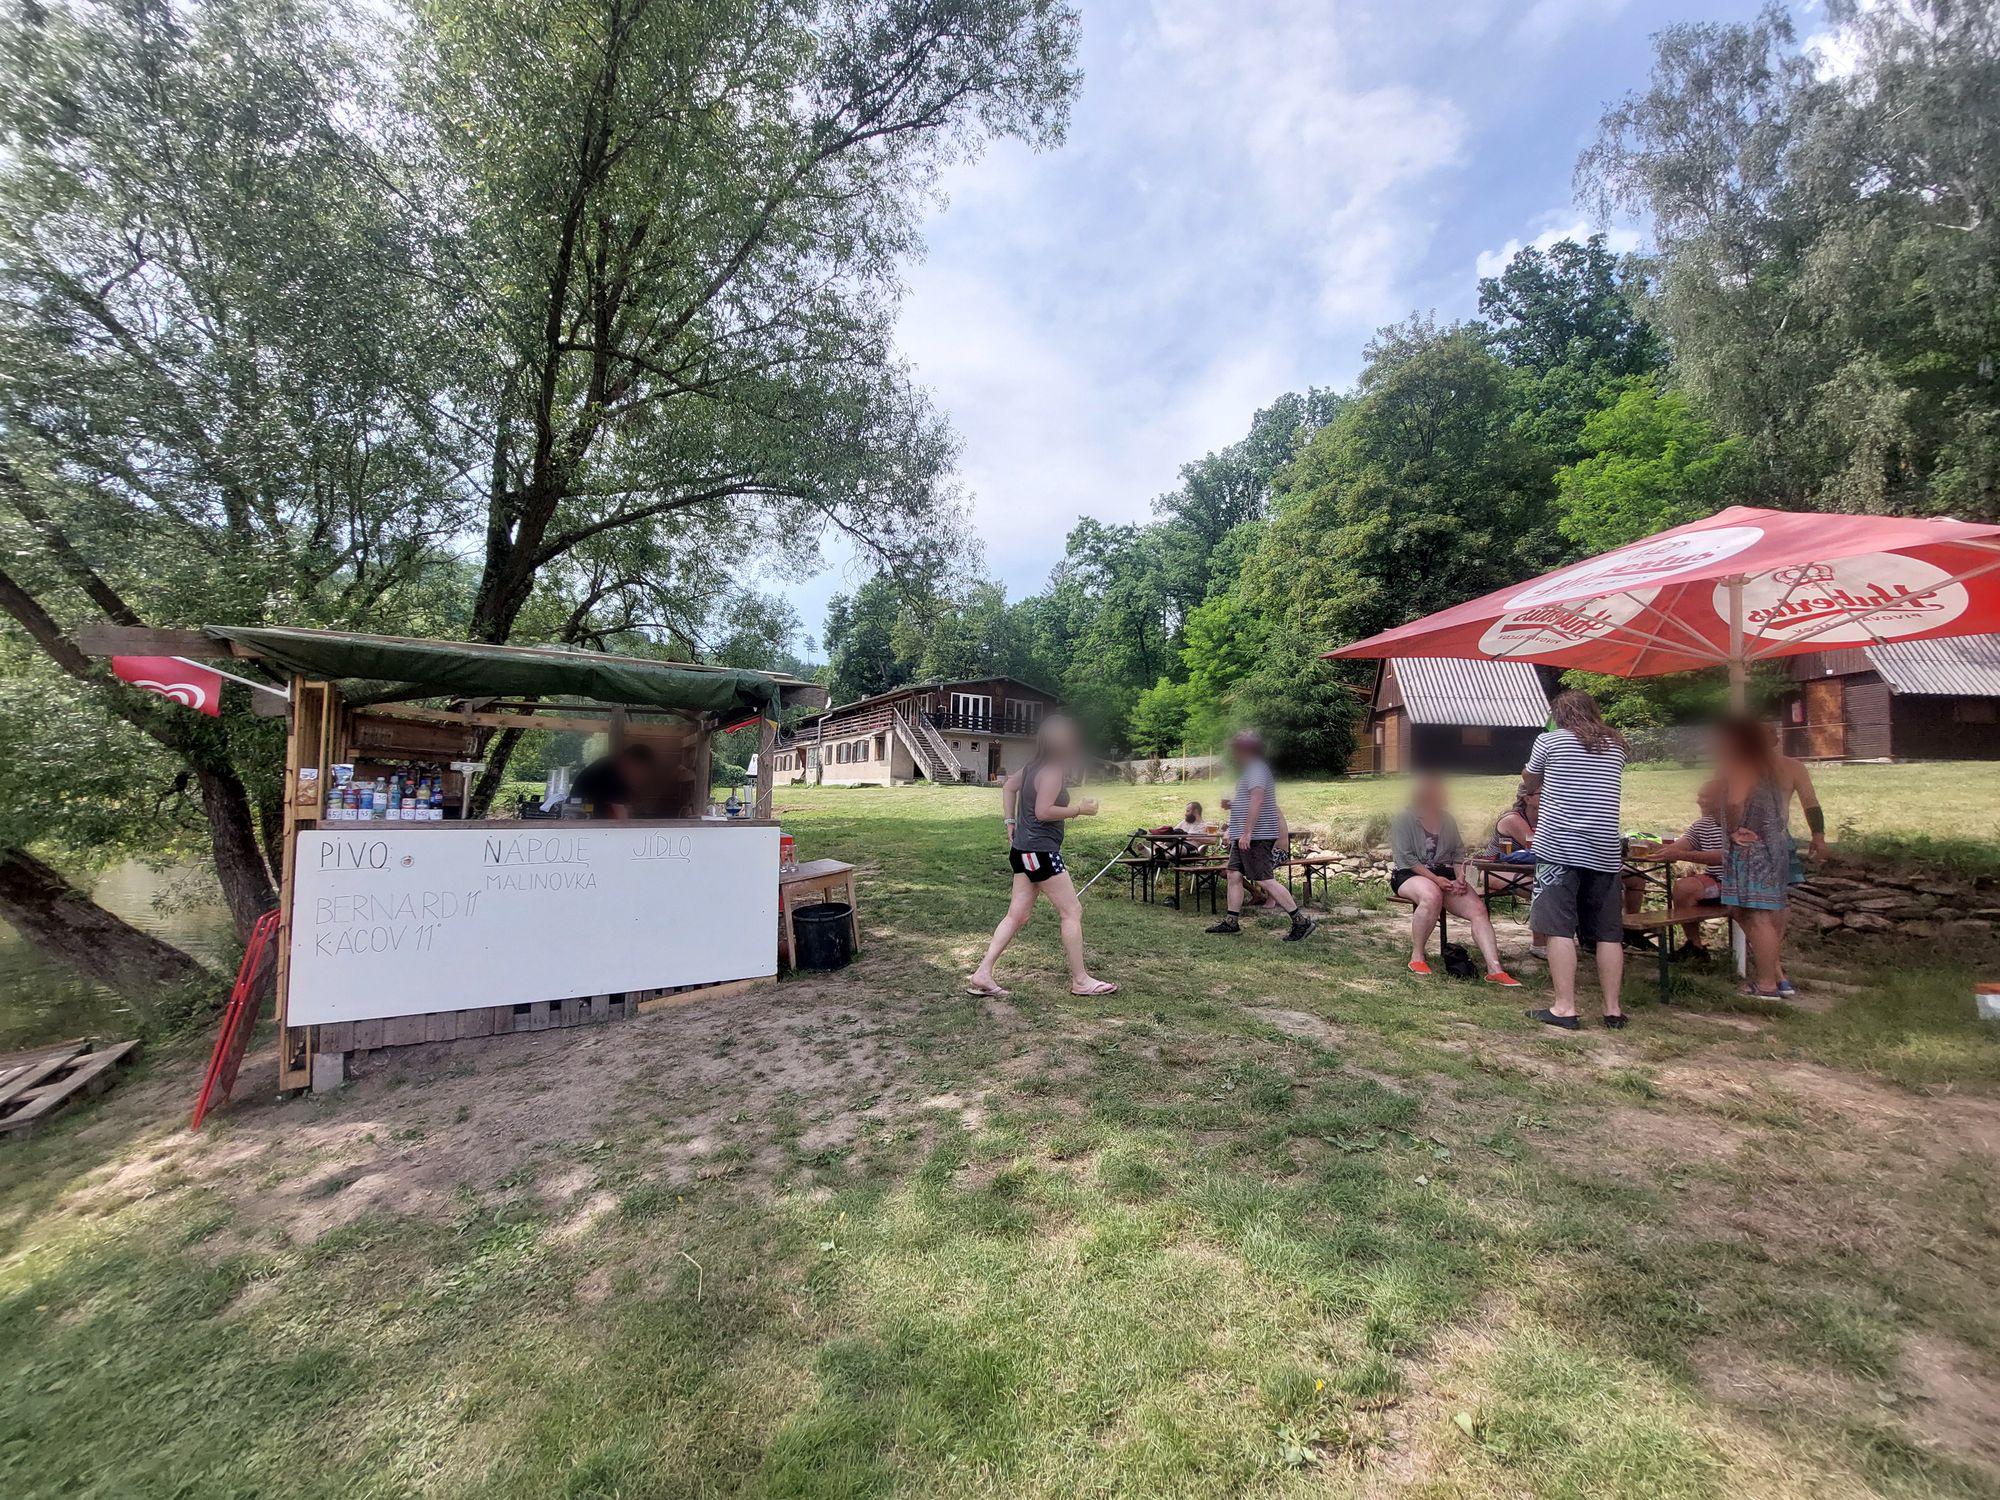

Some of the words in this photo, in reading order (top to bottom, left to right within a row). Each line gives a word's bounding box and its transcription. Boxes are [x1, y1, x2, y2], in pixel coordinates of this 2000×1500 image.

[484, 834, 592, 863] NÁPOJE
[632, 830, 692, 857] JÍDLO
[486, 871, 598, 892] MALINOVKA
[315, 890, 458, 925] BERNARD
[315, 925, 408, 957] KÁCOV
